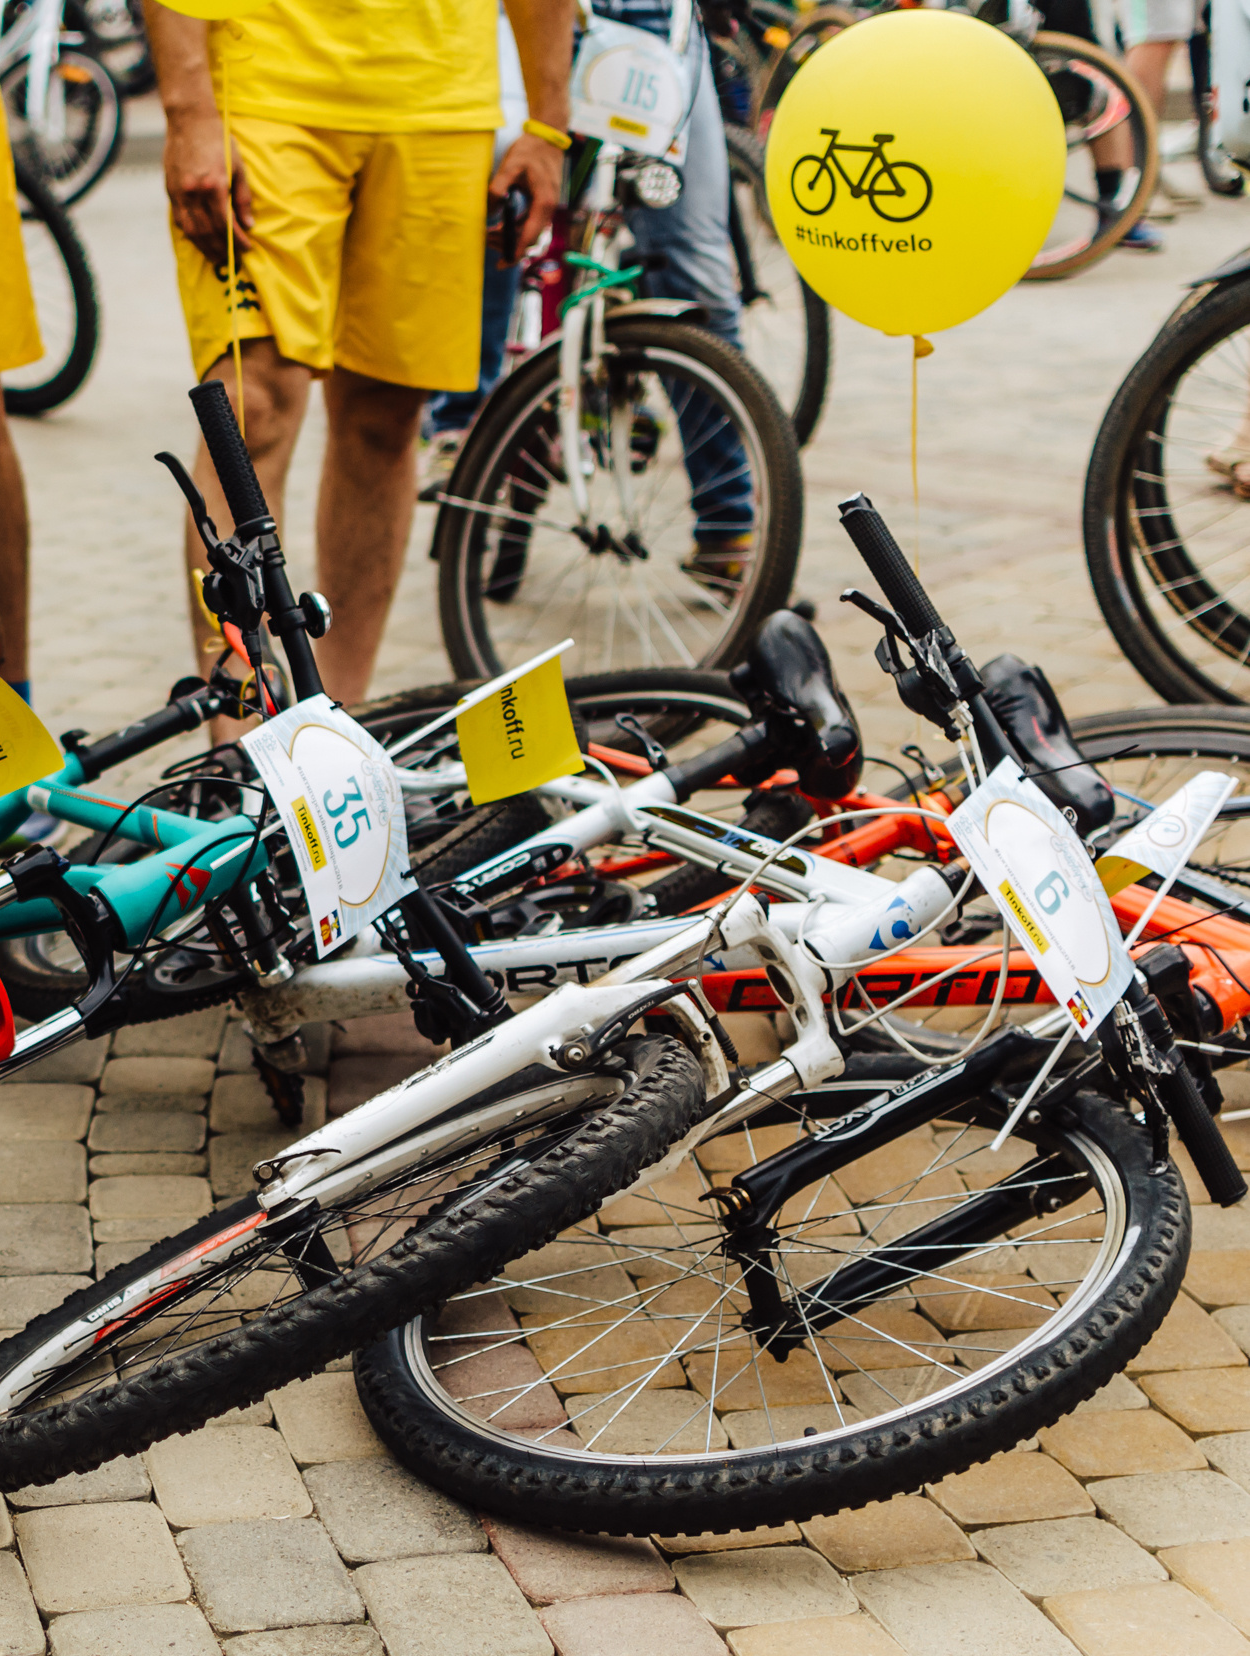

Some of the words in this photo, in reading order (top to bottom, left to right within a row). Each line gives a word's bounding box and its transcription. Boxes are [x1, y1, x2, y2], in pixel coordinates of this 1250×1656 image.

[622, 67, 660, 111] 115
[795, 223, 933, 254] #tinkoffvelo
[500, 680, 525, 760] inkoff.ru
[297, 803, 321, 865] Tinkoff.ru
[323, 775, 371, 849] 35
[1034, 870, 1070, 916] 6
[1005, 887, 1044, 948] Tinkoff.ru
[483, 952, 648, 994] ORT
[726, 970, 1041, 1013] CRTO
